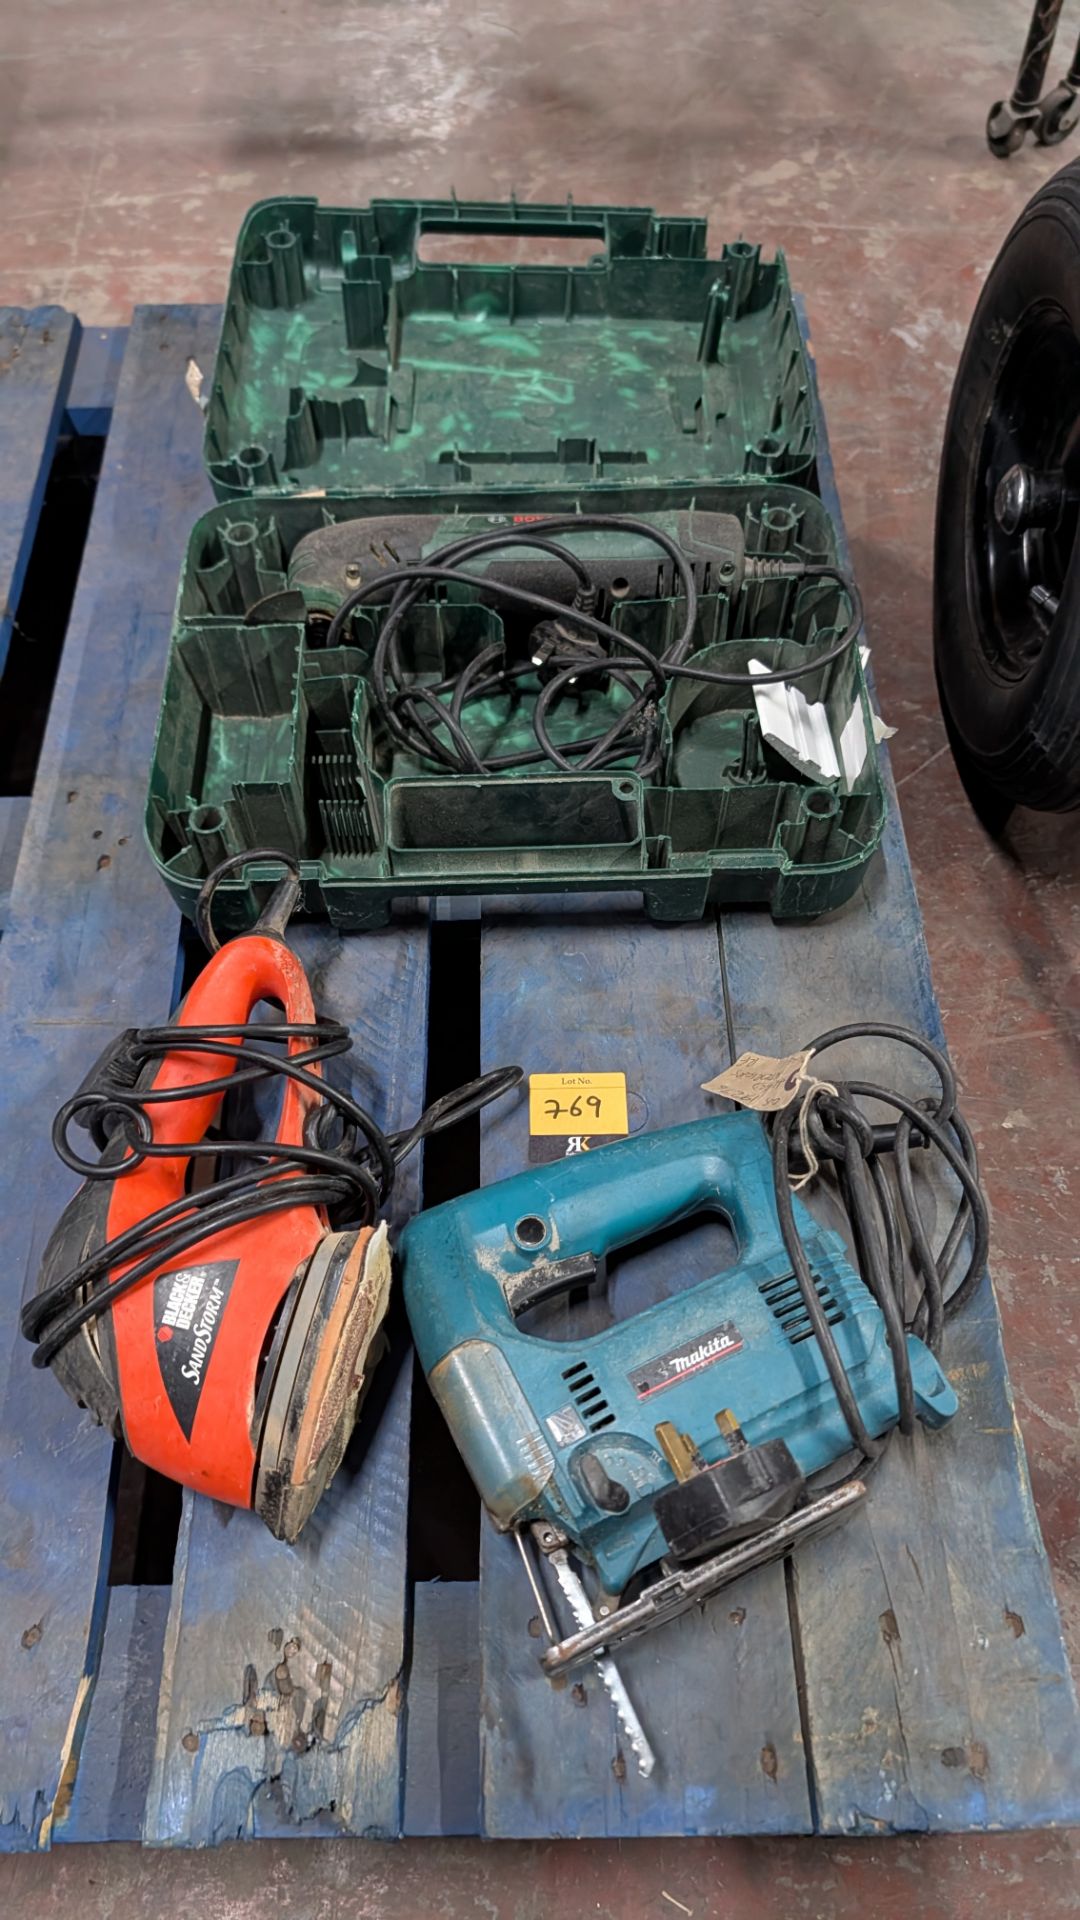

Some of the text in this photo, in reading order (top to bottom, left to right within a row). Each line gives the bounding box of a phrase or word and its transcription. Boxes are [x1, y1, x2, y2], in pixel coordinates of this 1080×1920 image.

[561, 1077, 592, 1085] Lot No.
[545, 1096, 601, 1119] 769
[175, 1275, 206, 1330] DECKER
